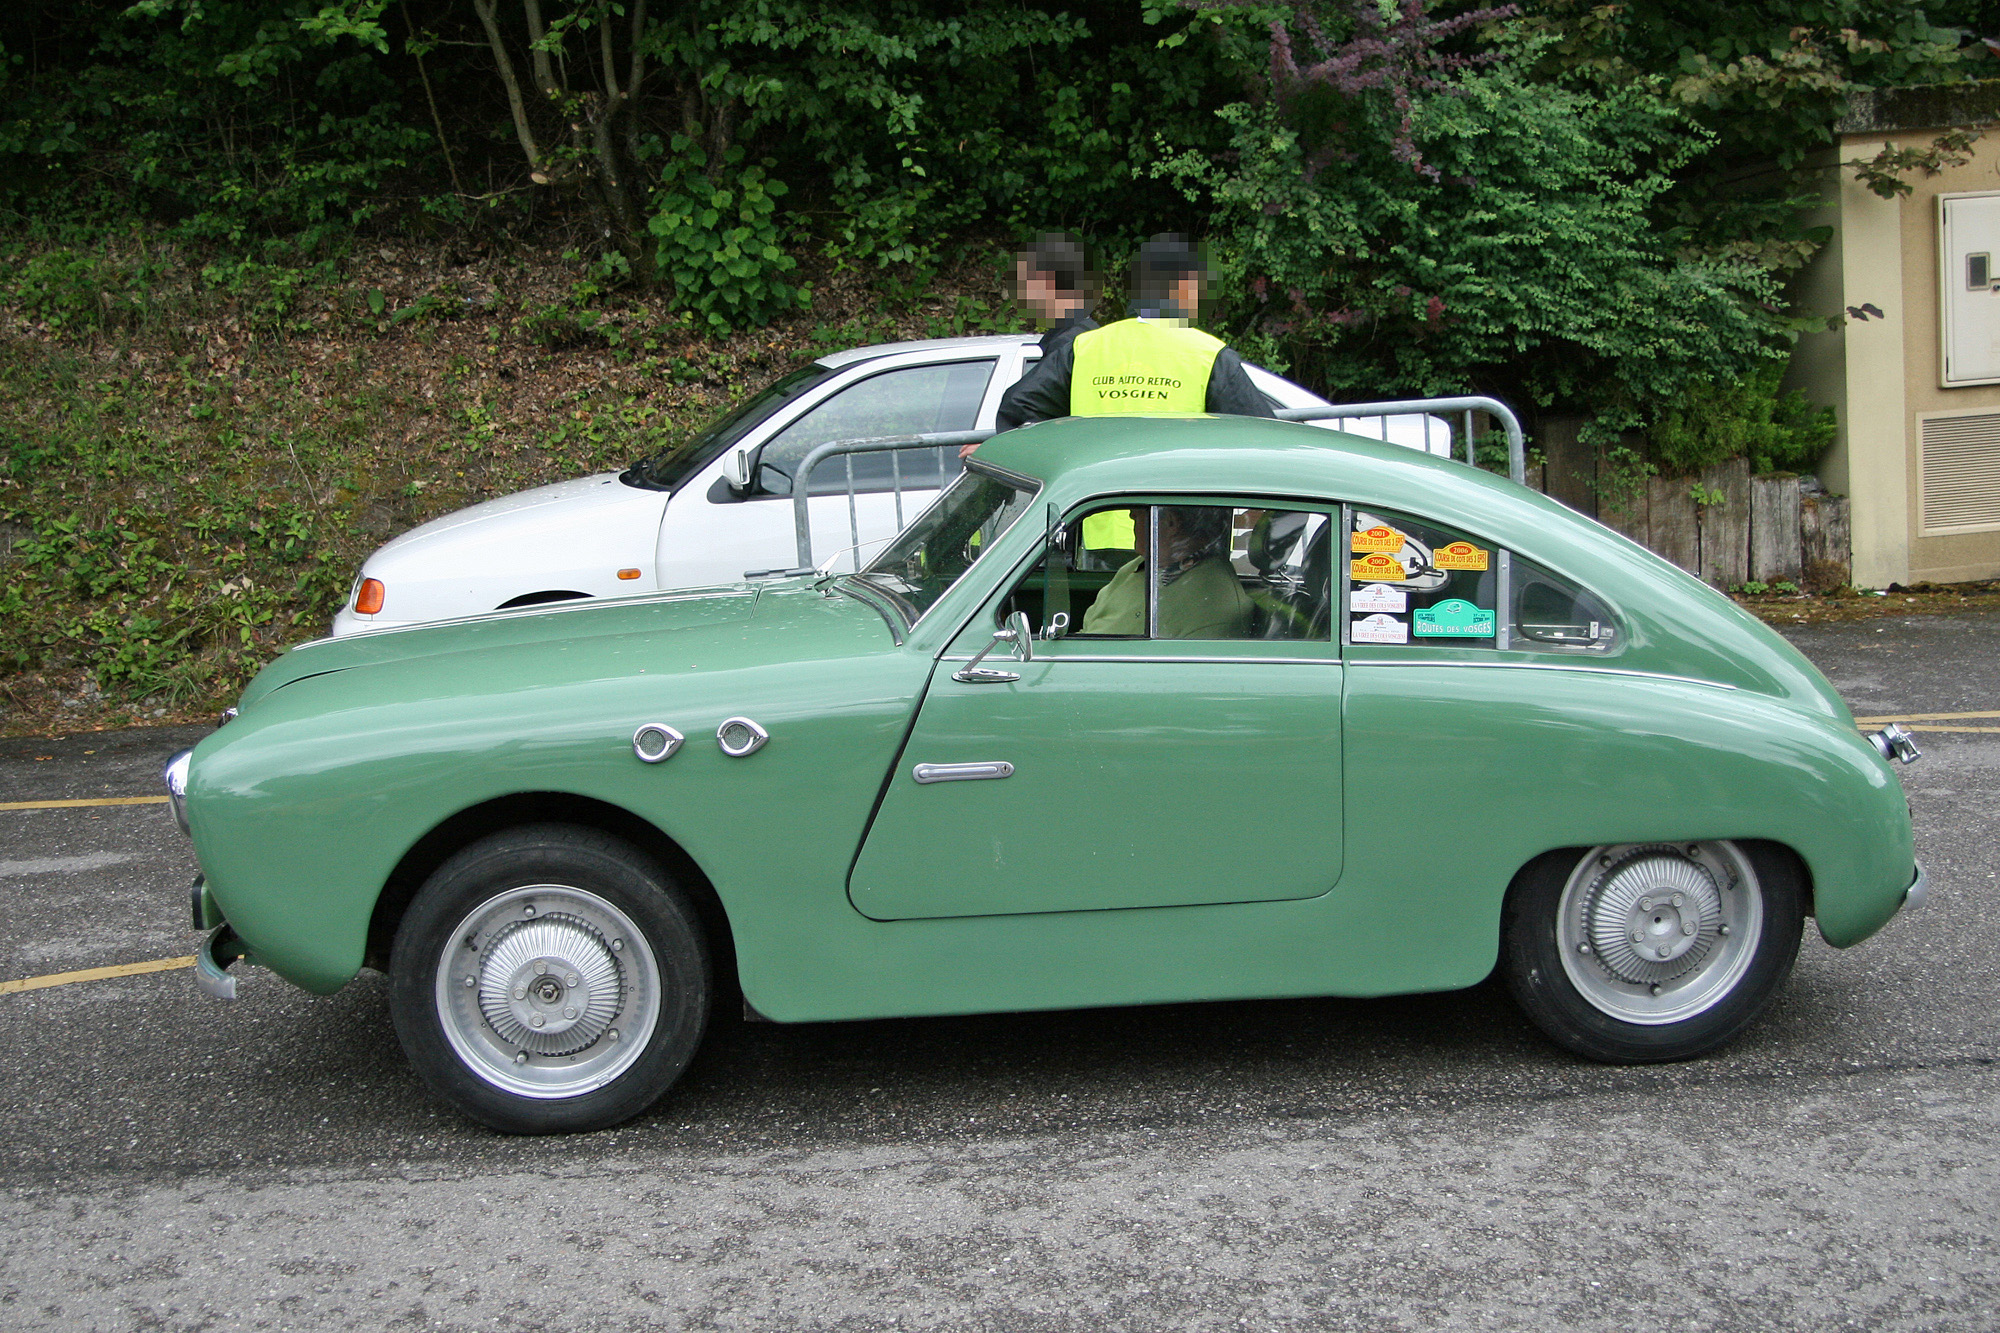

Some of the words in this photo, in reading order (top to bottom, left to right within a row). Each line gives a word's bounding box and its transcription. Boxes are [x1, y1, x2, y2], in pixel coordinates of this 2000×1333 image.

[1093, 376, 1114, 386] CLUB
[1118, 376, 1144, 385] AUTO
[1148, 377, 1182, 388] RETRO
[1098, 389, 1169, 400] VOSGIEN
[1352, 535, 1367, 545] COURSE
[1435, 552, 1450, 562] COURSE
[1352, 563, 1368, 573] COURSE
[1417, 622, 1443, 633] ROUTES
[1464, 622, 1491, 633] VOSGES
